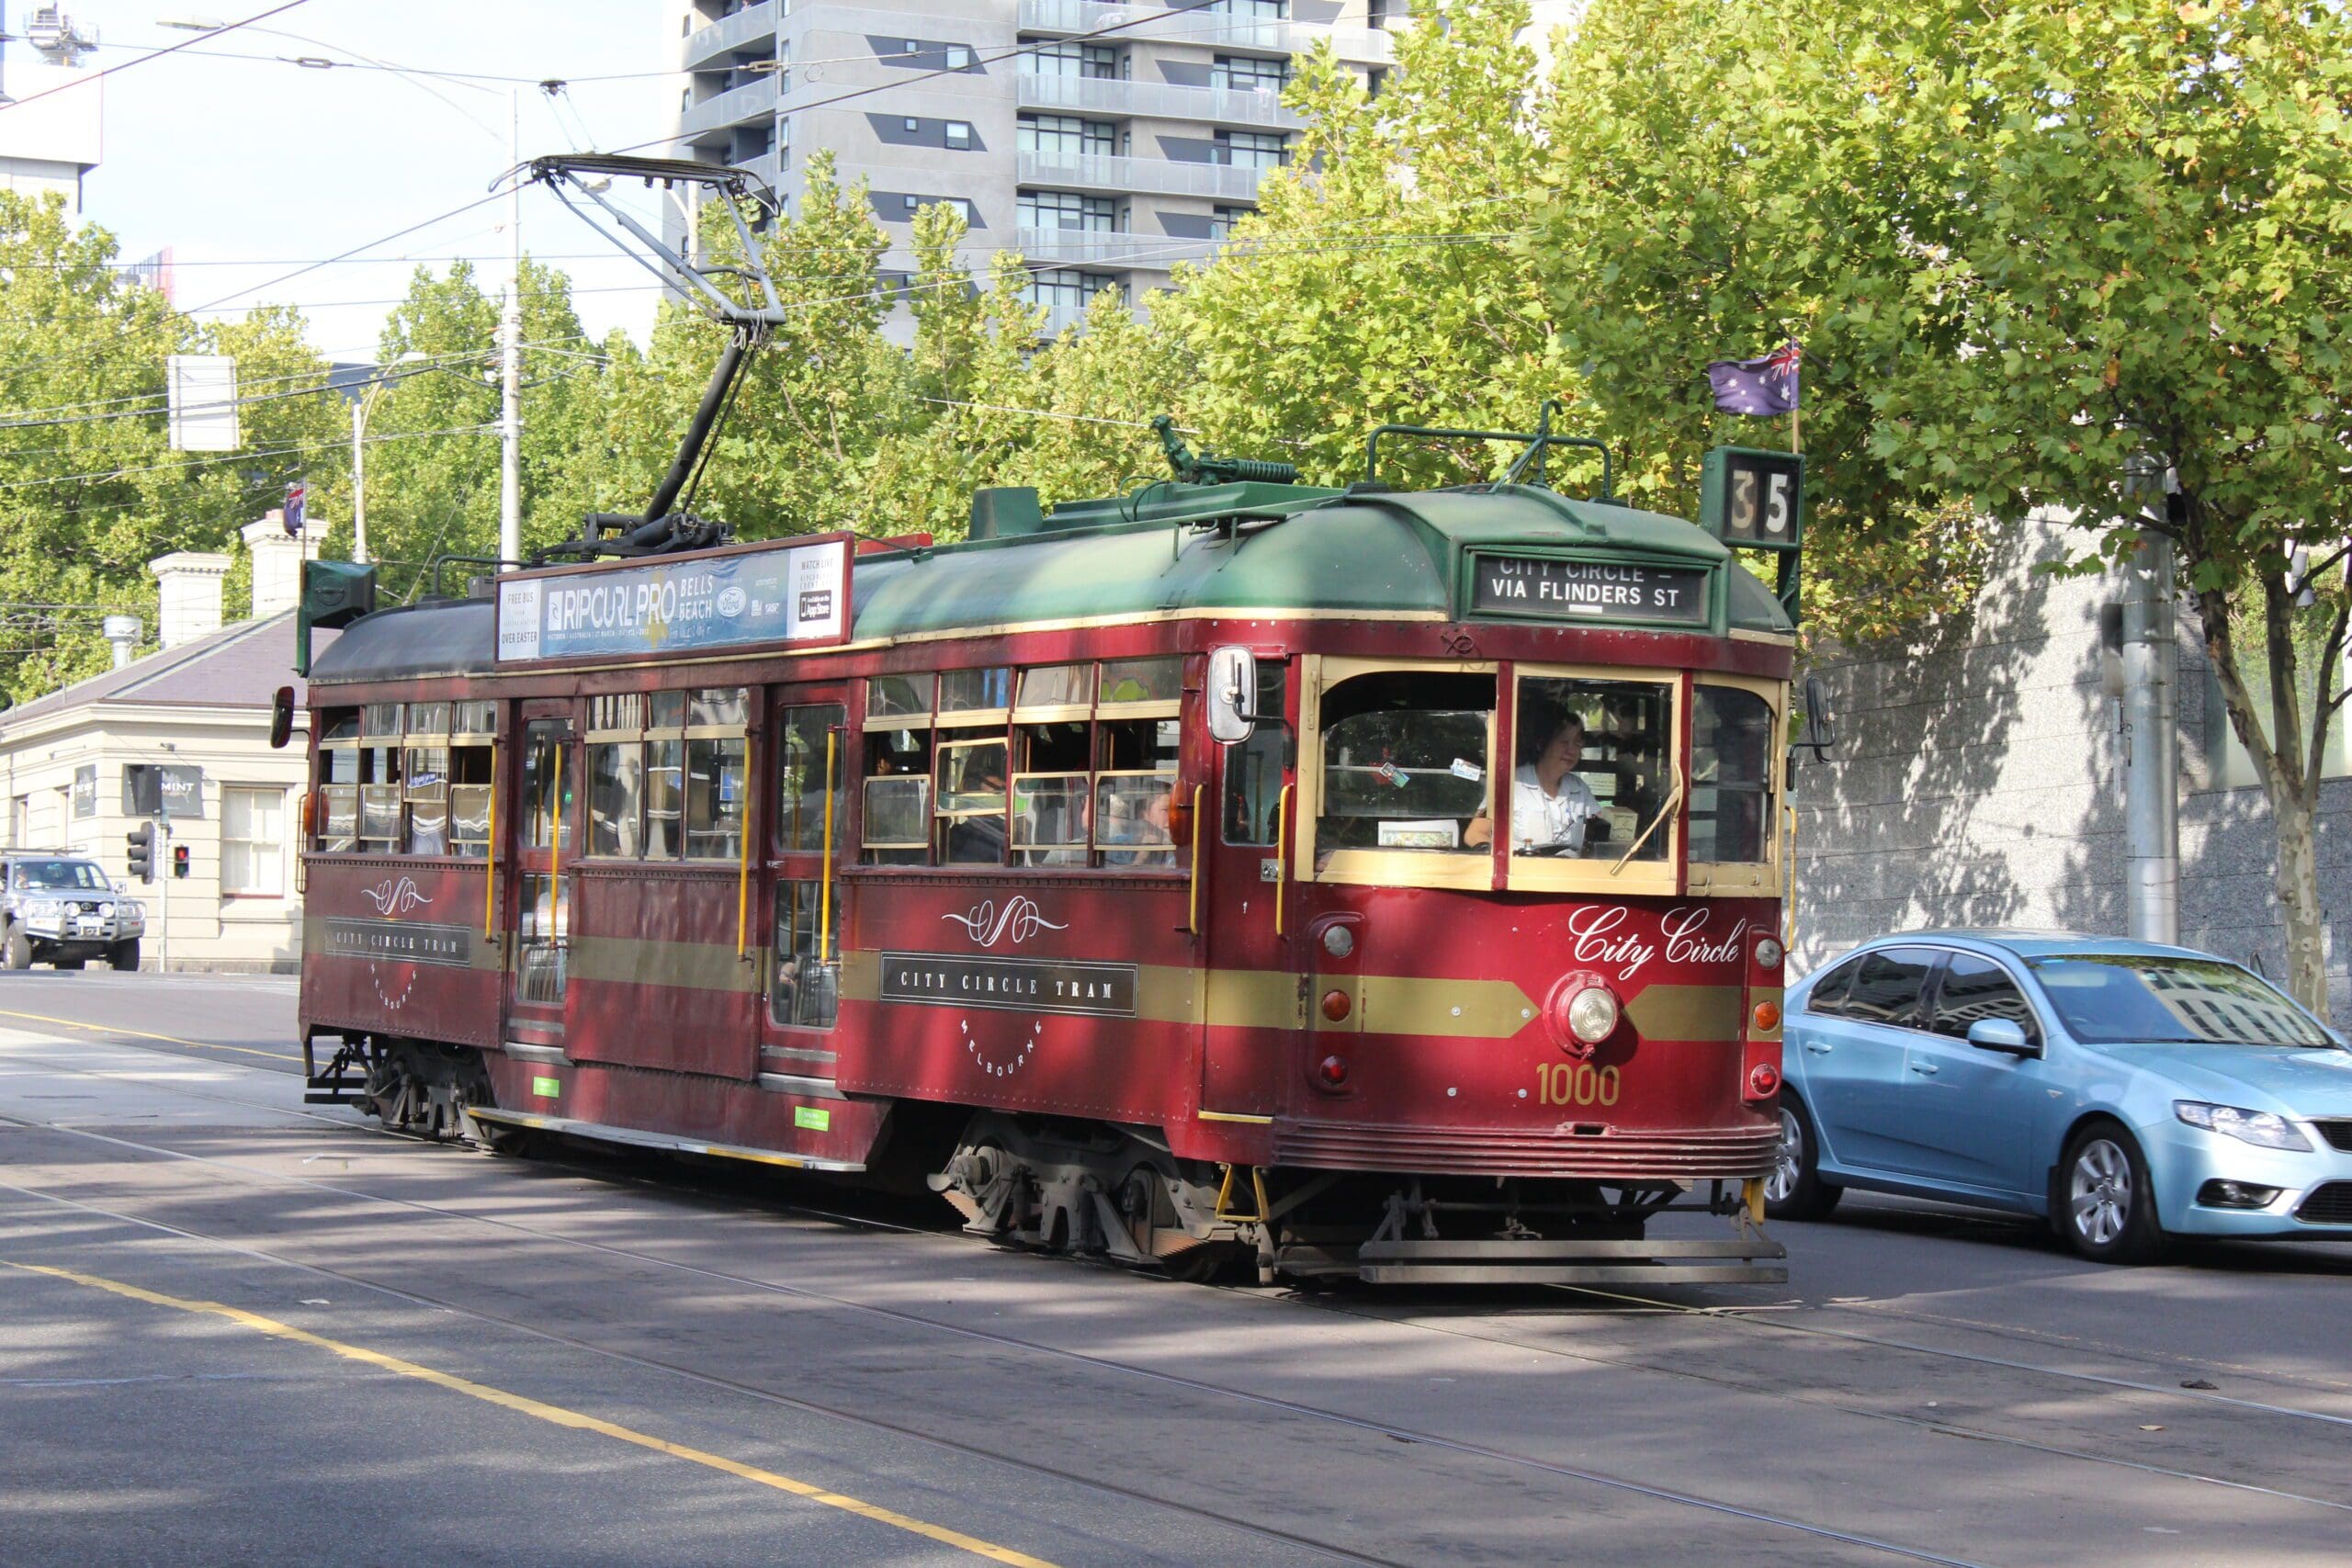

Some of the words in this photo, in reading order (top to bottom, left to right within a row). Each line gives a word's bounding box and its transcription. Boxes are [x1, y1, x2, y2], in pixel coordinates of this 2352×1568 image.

[1731, 469, 1788, 533] 35
[1566, 563, 1645, 582] CIRCLE
[507, 592, 522, 604] FREE
[522, 592, 534, 604] BUS
[680, 574, 714, 597] BELLS
[1492, 579, 1527, 598] VIA
[1539, 581, 1641, 605] FLINDERS
[1654, 589, 1679, 607] ST
[635, 580, 676, 626] PRO
[679, 599, 712, 622] BEACH
[501, 632, 515, 644] OVER
[516, 631, 537, 644] EASTER
[161, 782, 195, 792] MINT
[336, 931, 363, 945] CITY
[371, 935, 414, 950] CIRCLE
[424, 939, 457, 953] TRAM
[1567, 905, 1655, 981] City
[1661, 907, 1747, 964] Circle
[900, 971, 945, 988] CITY
[962, 975, 1037, 995] CIRCLE
[1057, 981, 1112, 999] TRAM
[961, 1019, 1042, 1077] MELBOURNE
[1536, 1062, 1621, 1106] 1000
